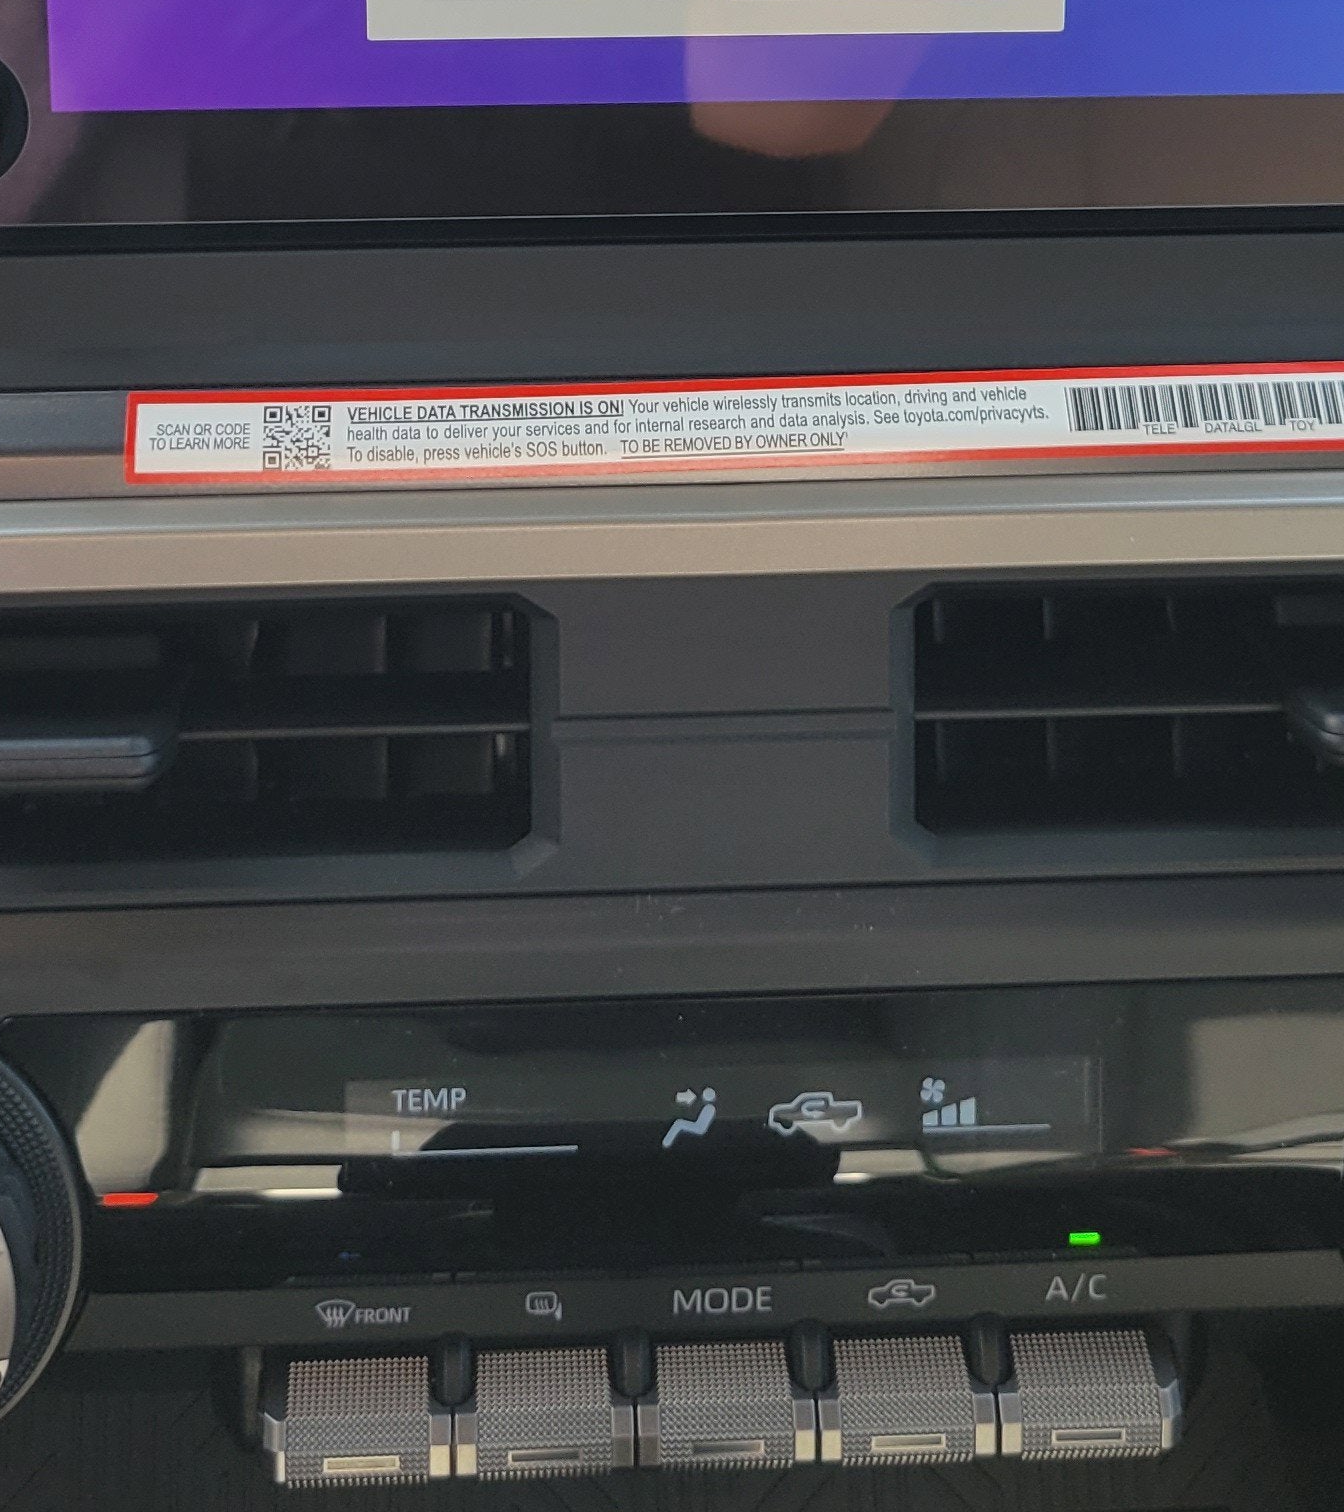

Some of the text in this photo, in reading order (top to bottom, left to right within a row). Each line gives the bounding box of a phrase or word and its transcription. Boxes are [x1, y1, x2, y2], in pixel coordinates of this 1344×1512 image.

[347, 405, 413, 422] VEHICLE
[417, 404, 457, 420] DATA
[459, 401, 576, 419] TRANSMISSION
[579, 400, 594, 416] IS
[628, 397, 659, 414] Your
[662, 397, 709, 413] vehicle
[713, 394, 778, 412] wirelessly
[781, 392, 842, 409] transmits
[844, 390, 902, 407] location,
[904, 388, 948, 406] driving
[952, 387, 977, 403] and
[980, 385, 1027, 401] vehicle
[156, 422, 251, 436] SCAN QR CODE
[347, 404, 1050, 441] health data to deliver your services and for internal research and data analysis. See toyota.com/privacyvts.
[1142, 422, 1177, 435] TELE
[1288, 419, 1316, 432] TOY
[149, 436, 251, 451] TO LEARN MORE
[346, 446, 363, 463] To
[366, 444, 420, 464] disable,
[423, 446, 461, 465] press
[464, 442, 522, 459] vehicle's
[526, 440, 558, 457] SOS
[561, 439, 608, 457] button.
[620, 438, 639, 455] TO
[642, 438, 661, 454] BE
[664, 435, 732, 453] REMOVED
[735, 434, 753, 450] BY
[756, 432, 807, 449] OWNER
[391, 1087, 467, 1113] TEMP
[672, 1285, 773, 1315] MODE
[1046, 1273, 1107, 1303] A/C
[356, 1306, 412, 1325] FRONT
